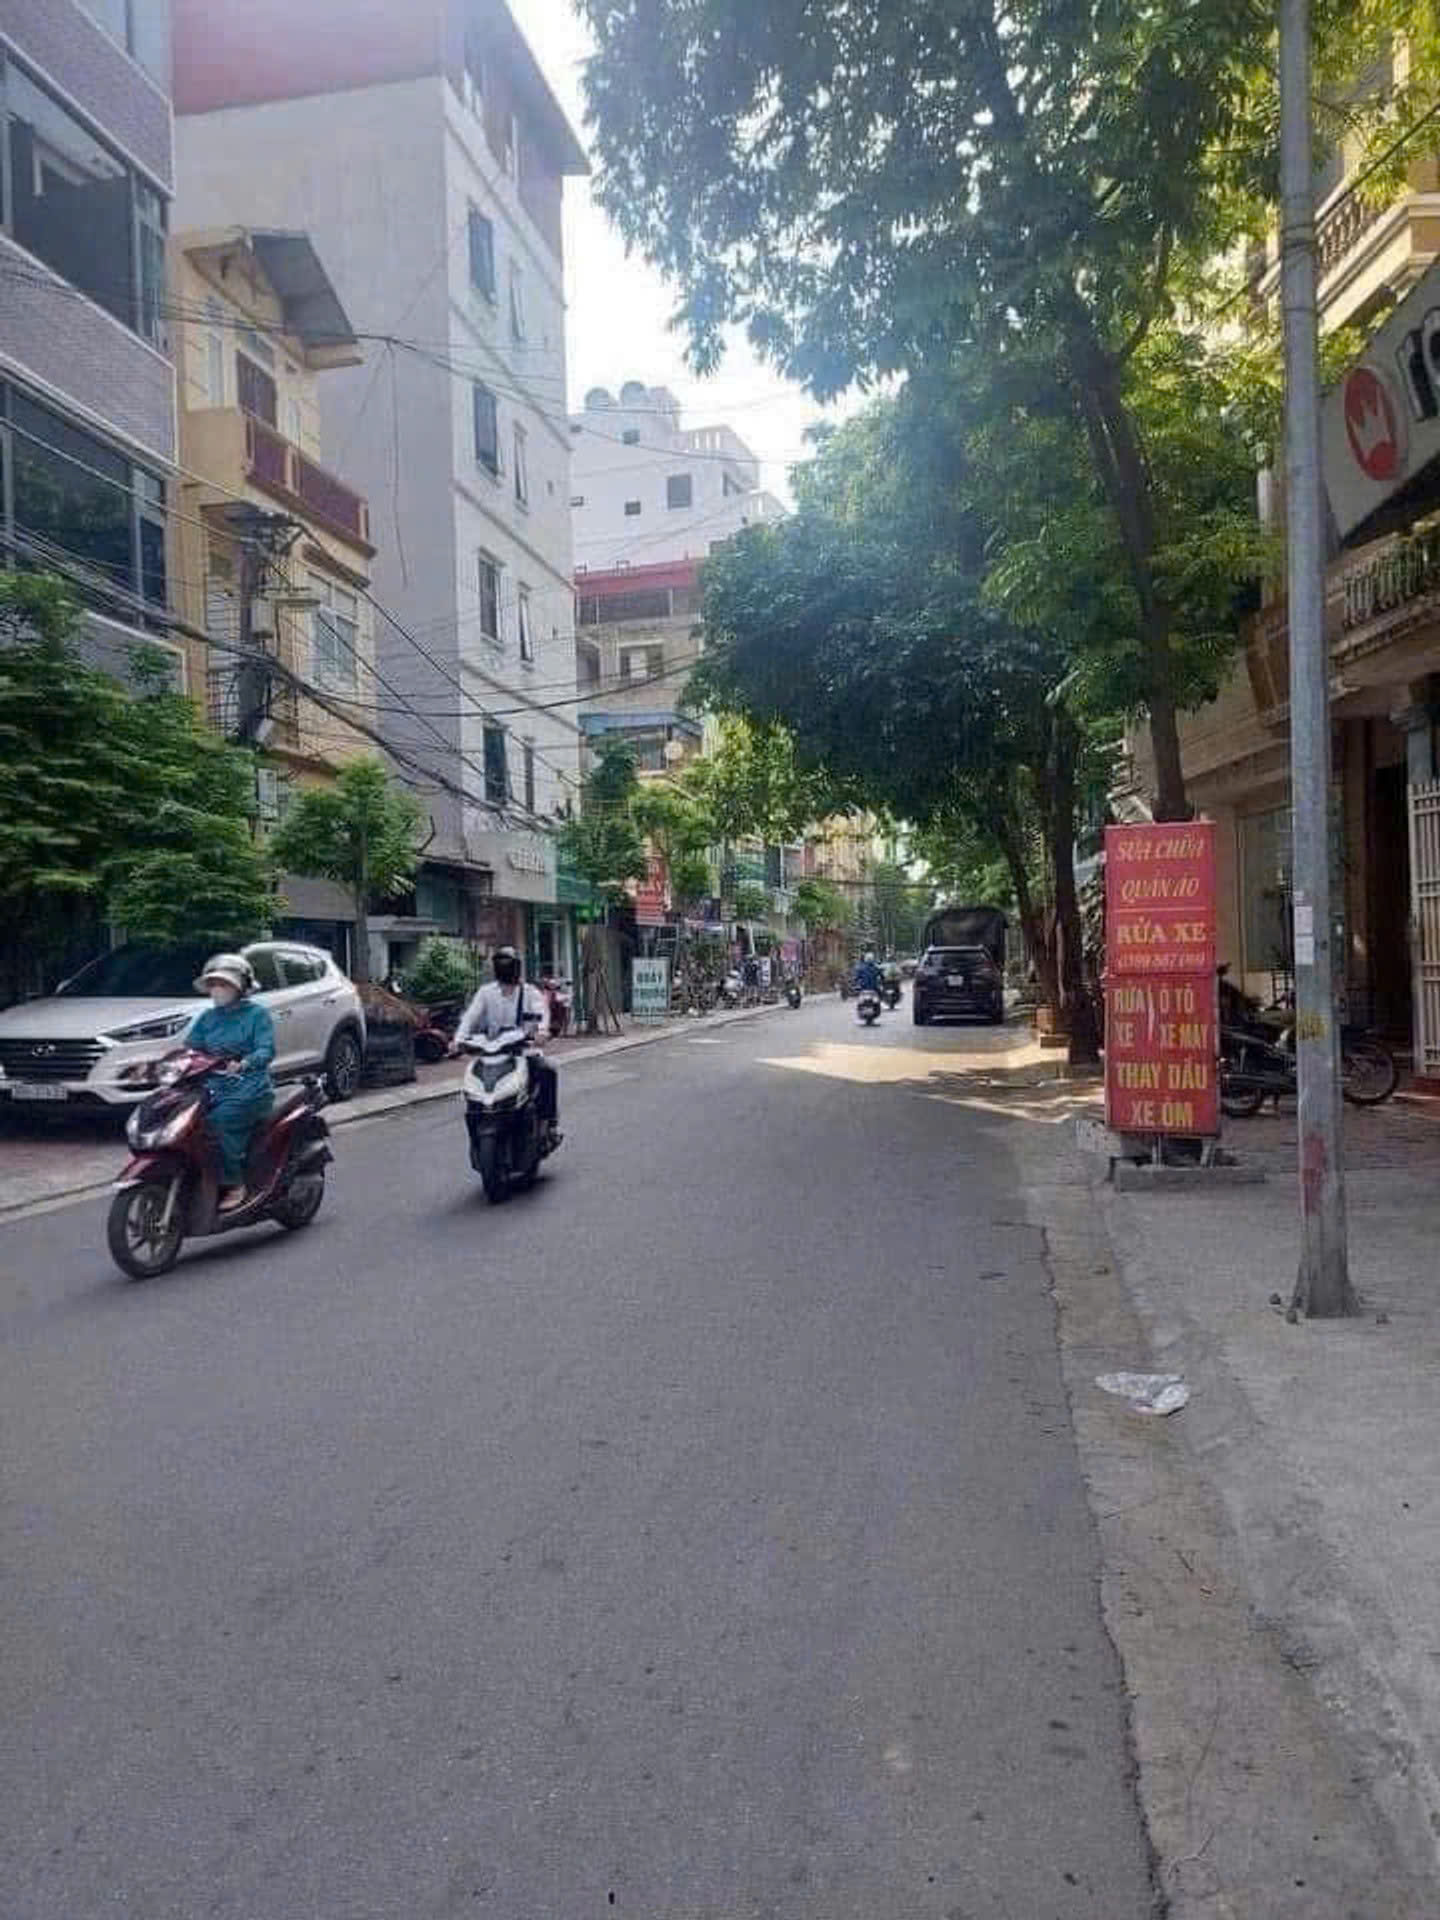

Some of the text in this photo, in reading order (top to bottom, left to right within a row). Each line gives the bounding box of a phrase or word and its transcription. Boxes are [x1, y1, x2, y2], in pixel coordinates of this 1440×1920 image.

[1118, 916, 1206, 944] RỬA XE
[1112, 979, 1146, 1014] RỬA
[1114, 1022, 1134, 1048] XE
[1160, 1022, 1180, 1050] XE
[1117, 1062, 1161, 1089] THAY
[1131, 1100, 1155, 1127] XE
